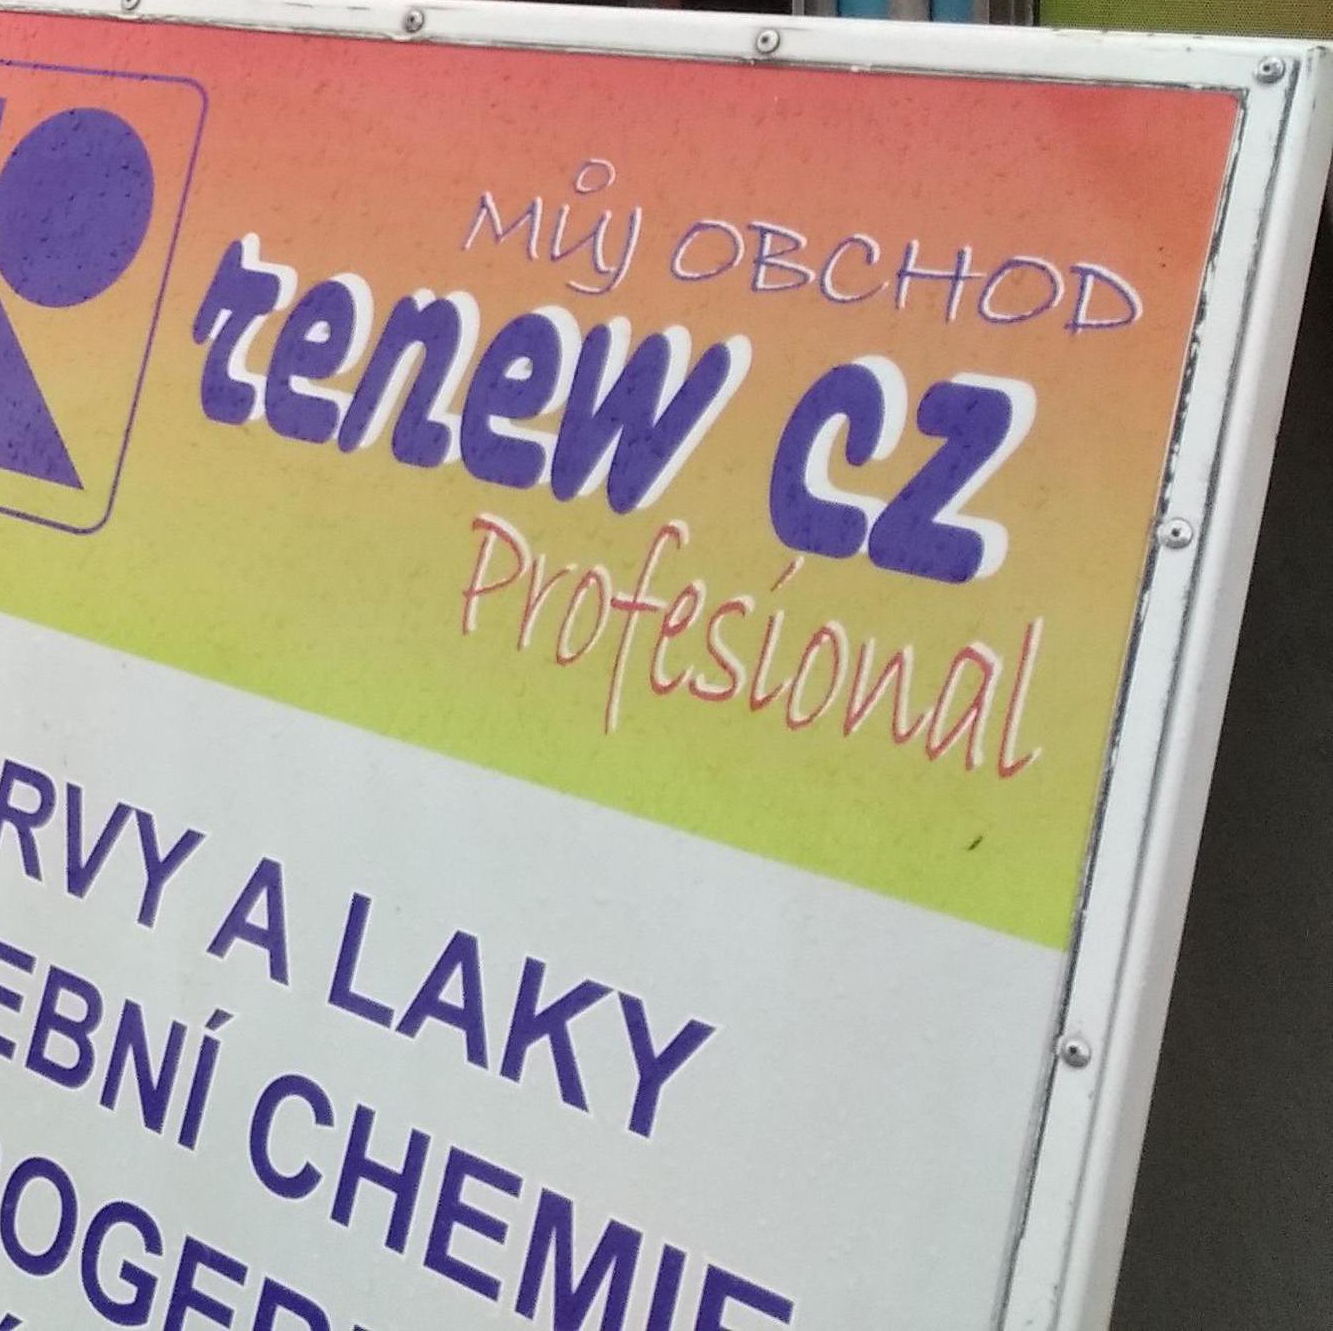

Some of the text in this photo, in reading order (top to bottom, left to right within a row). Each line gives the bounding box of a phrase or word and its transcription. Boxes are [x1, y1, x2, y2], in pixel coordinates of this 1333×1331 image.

[193, 233, 750, 514] renew
[672, 217, 1144, 336] OBCHOD
[208, 857, 294, 986] A
[328, 892, 716, 1139] LAKY
